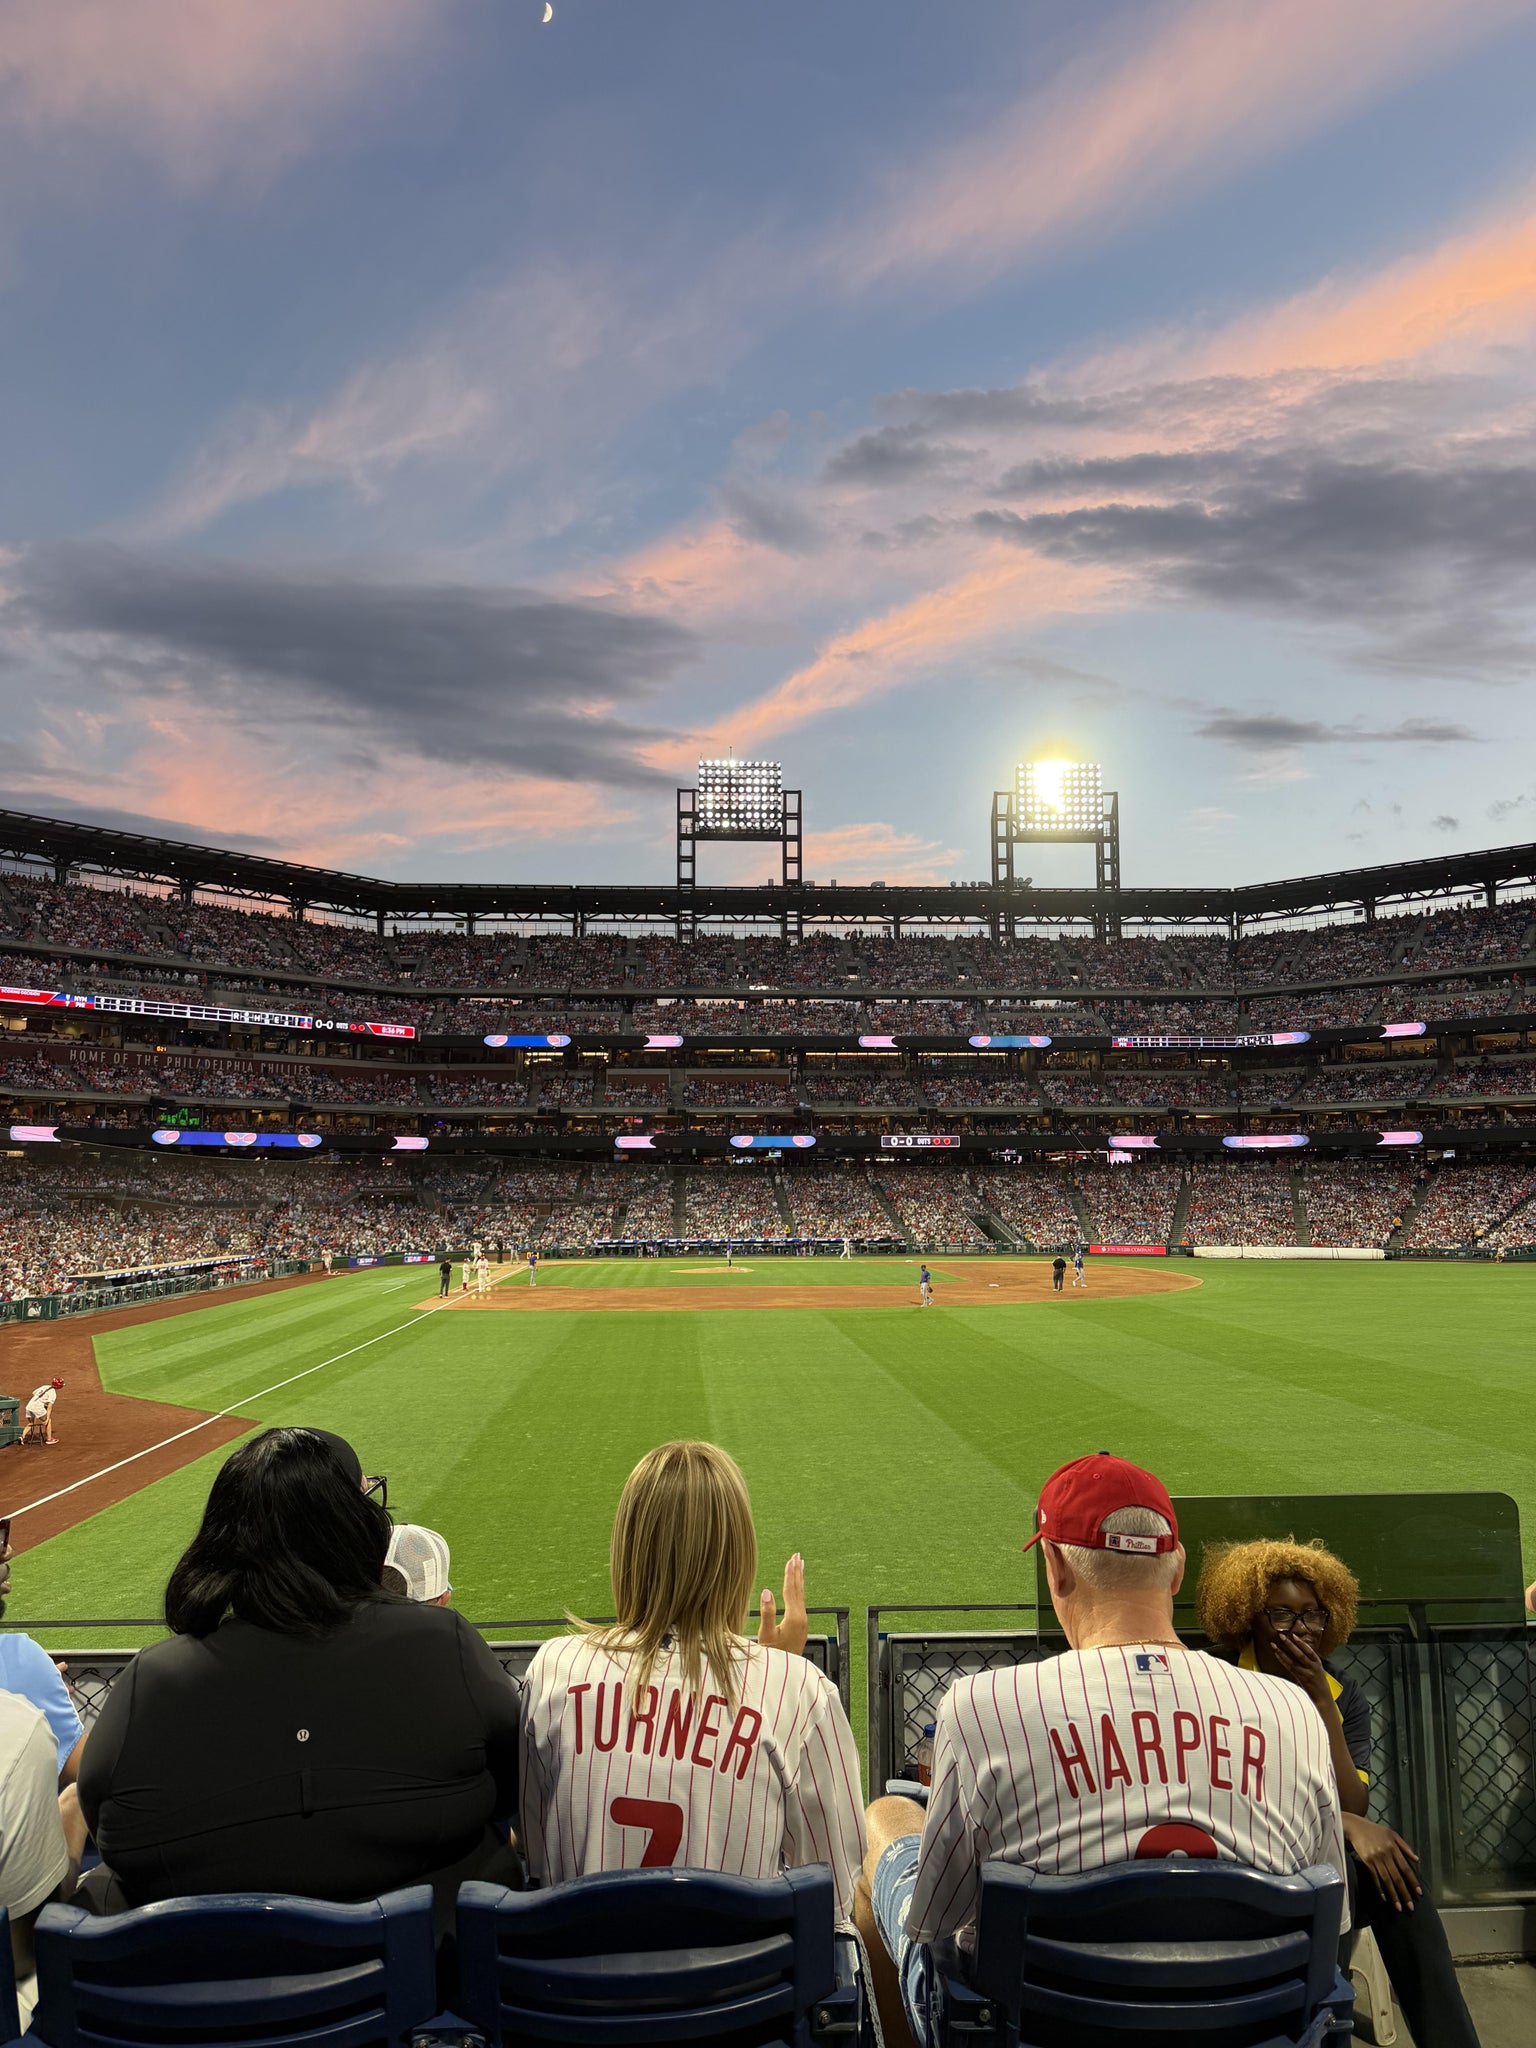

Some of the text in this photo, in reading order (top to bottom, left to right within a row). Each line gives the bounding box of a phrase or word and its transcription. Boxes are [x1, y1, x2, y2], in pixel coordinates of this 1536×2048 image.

[69, 1049, 311, 1076] HOME OF THE PHILADELPHIA PHILLIES
[1125, 1538, 1151, 1550] Phillies
[568, 1681, 763, 1781] TURNER
[1050, 1710, 1267, 1803] HARPER
[610, 1796, 684, 1868] 7
